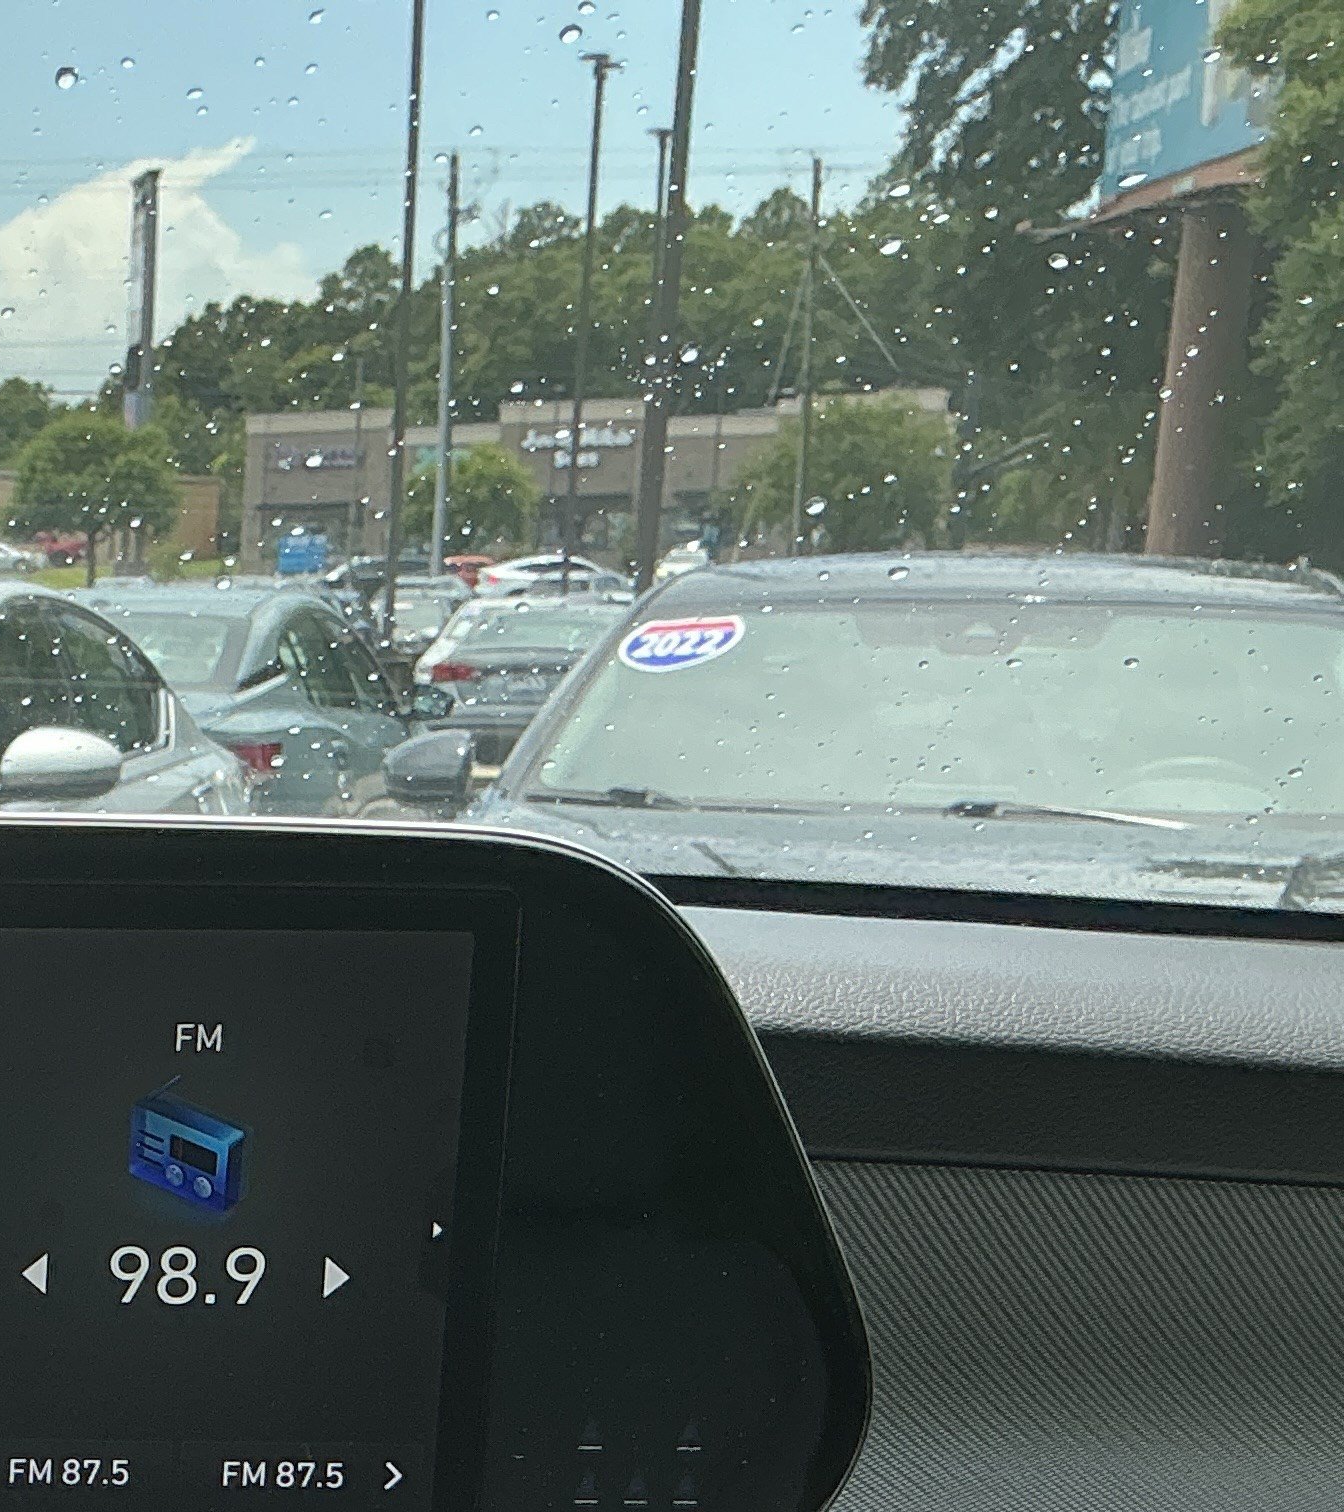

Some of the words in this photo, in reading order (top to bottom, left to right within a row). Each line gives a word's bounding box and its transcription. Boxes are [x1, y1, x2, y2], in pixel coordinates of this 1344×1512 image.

[631, 629, 726, 658] 2022
[175, 1023, 224, 1053] FM
[110, 1245, 267, 1306] 98.9
[8, 1458, 53, 1485] FM
[62, 1458, 130, 1486] 87.5
[222, 1461, 267, 1488] FM
[276, 1461, 344, 1489] 87.5
